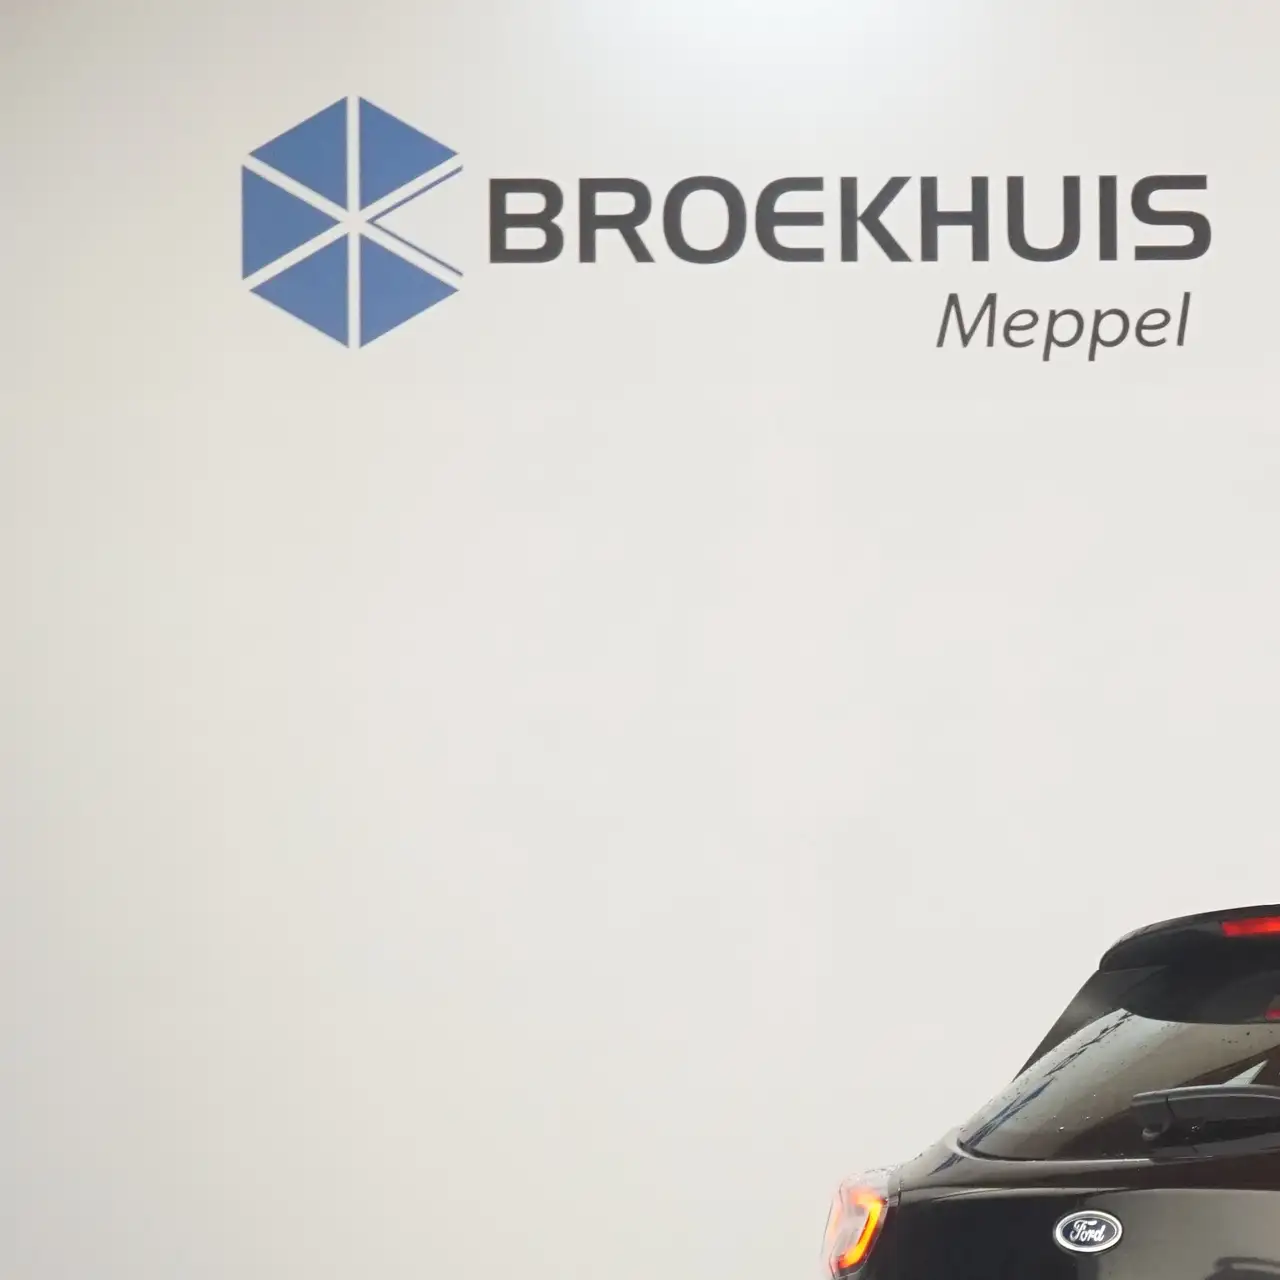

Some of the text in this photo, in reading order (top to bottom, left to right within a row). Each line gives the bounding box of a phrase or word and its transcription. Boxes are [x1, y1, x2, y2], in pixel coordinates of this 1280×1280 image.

[489, 174, 1212, 264] BROEKHUIS
[936, 291, 1191, 362] Meppel
[1069, 1219, 1106, 1242] Ford
